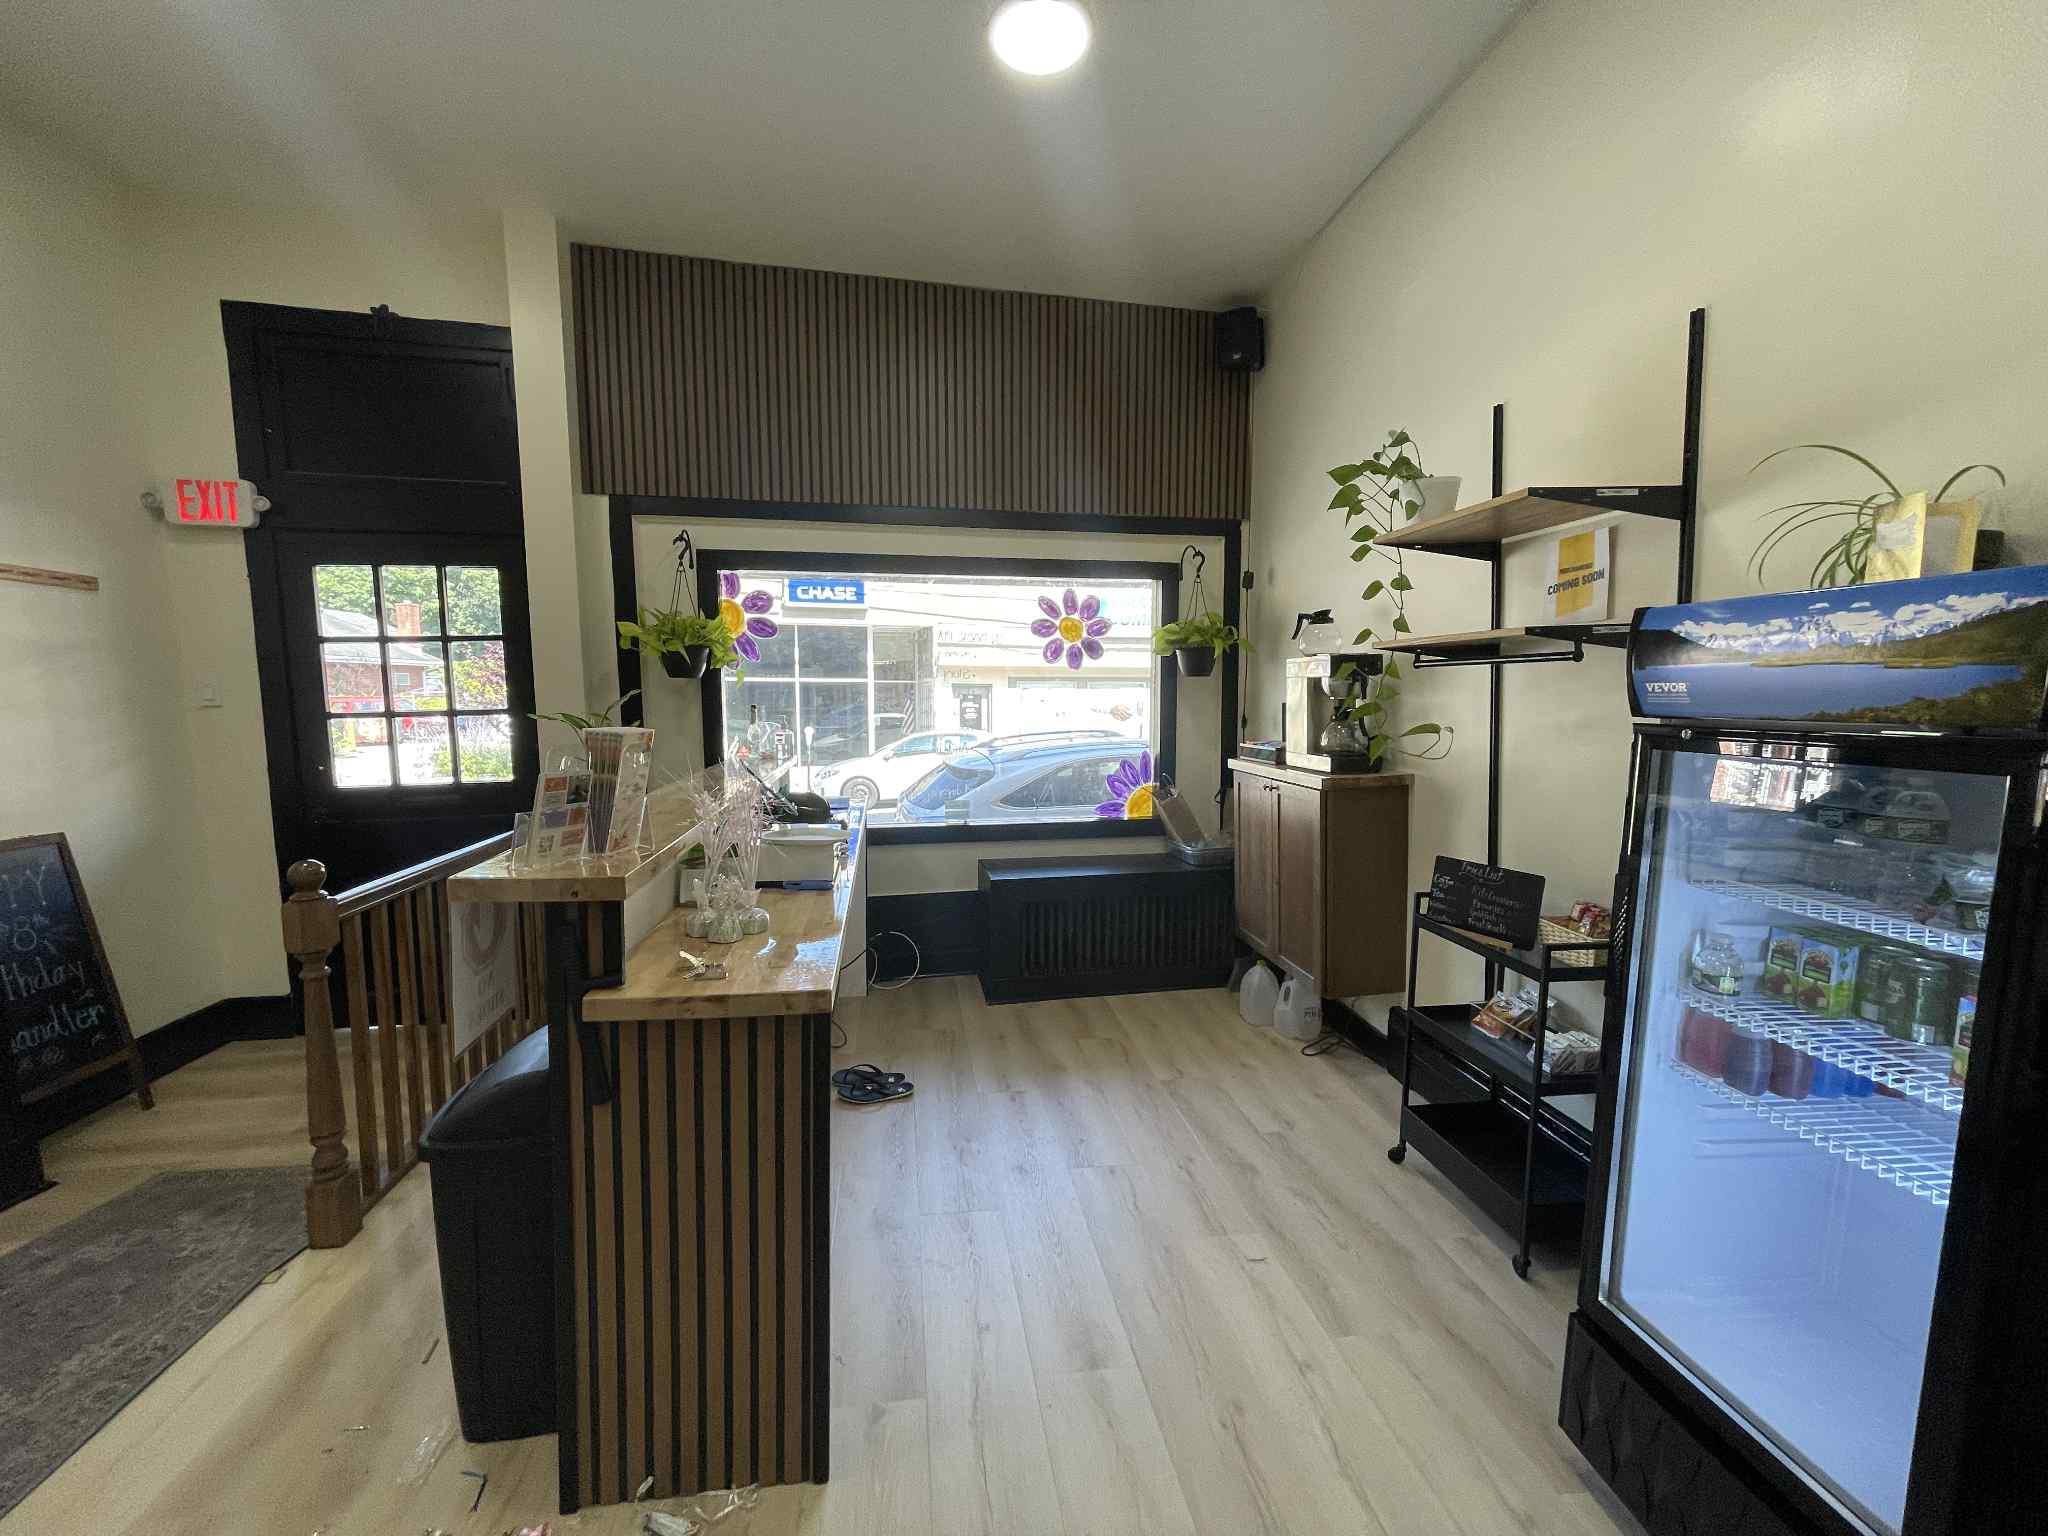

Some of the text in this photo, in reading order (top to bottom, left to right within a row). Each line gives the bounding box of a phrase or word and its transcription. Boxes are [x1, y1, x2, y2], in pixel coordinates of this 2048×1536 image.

[176, 479, 239, 523] EXIT
[1547, 578, 1580, 596] COMING
[1582, 567, 1605, 585] SOON
[796, 585, 857, 601] CHASE
[1646, 682, 1688, 693] VEVOR
